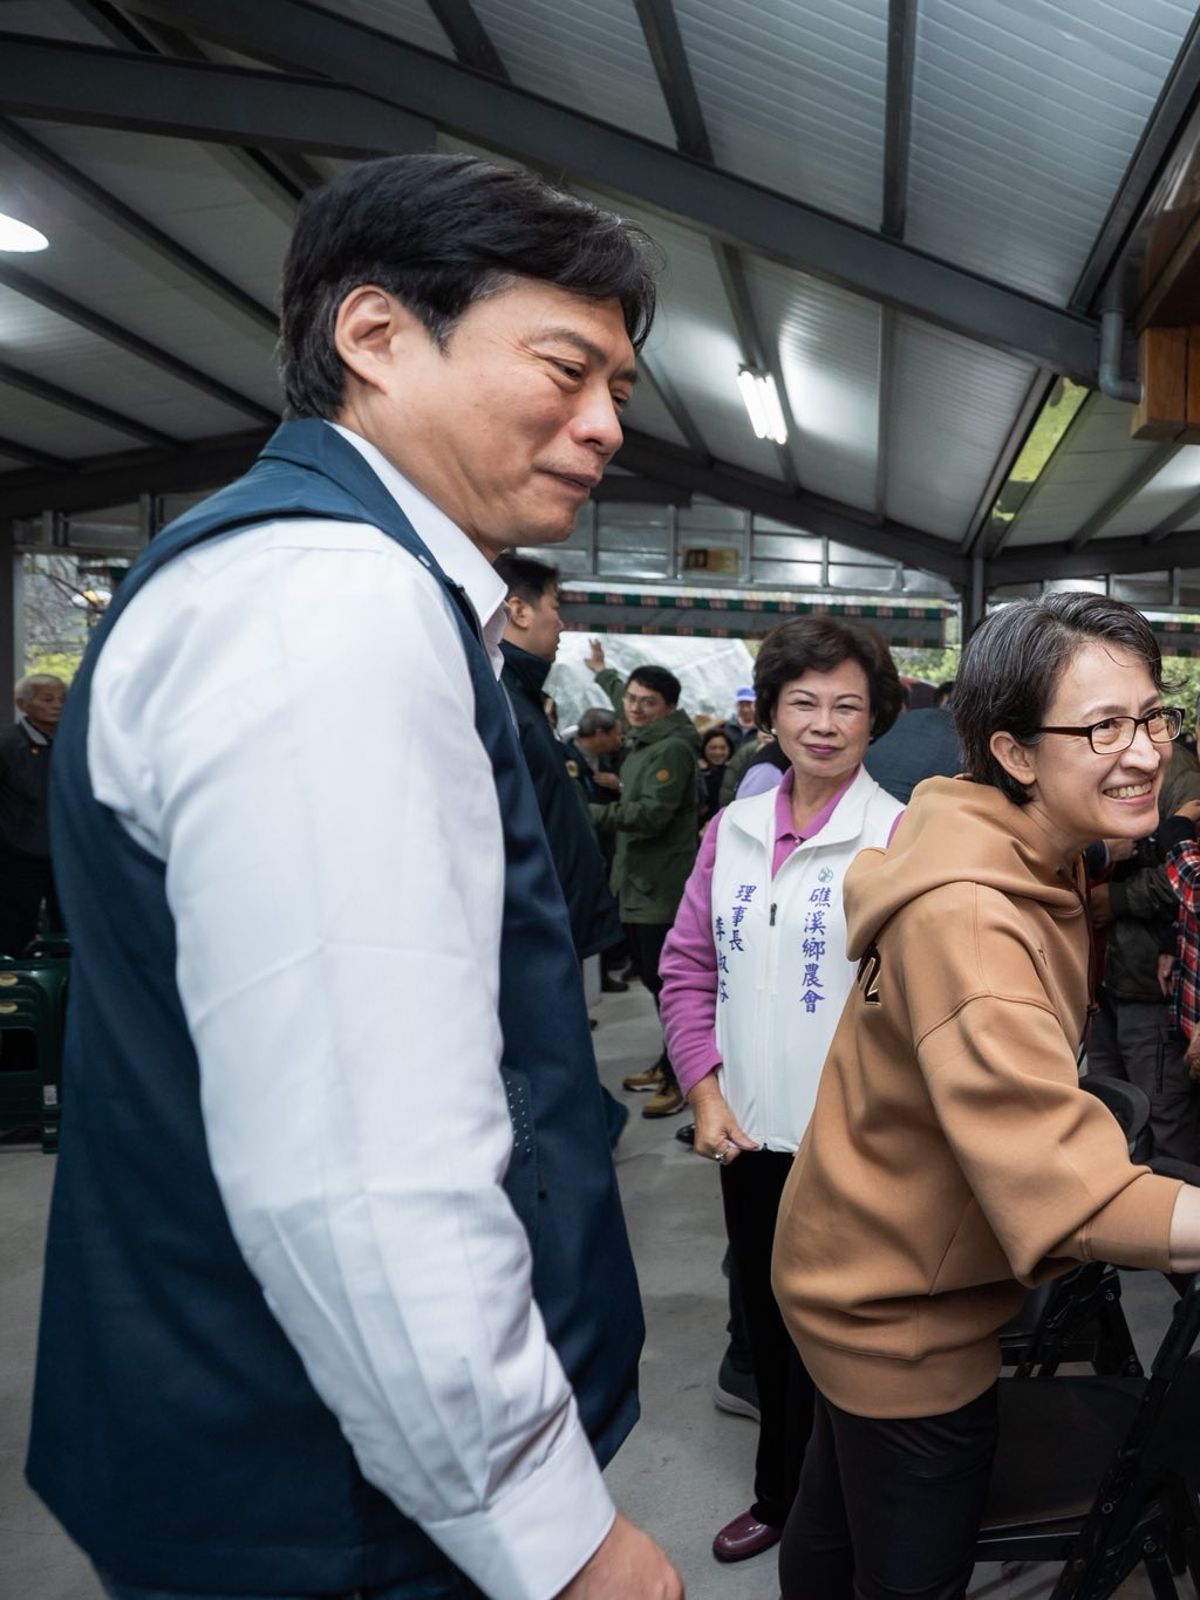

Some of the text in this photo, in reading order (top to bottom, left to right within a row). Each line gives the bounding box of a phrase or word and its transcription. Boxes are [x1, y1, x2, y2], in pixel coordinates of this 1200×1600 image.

[729, 885, 757, 951] 理事長
[800, 887, 832, 1013] 礁溪鄉農會
